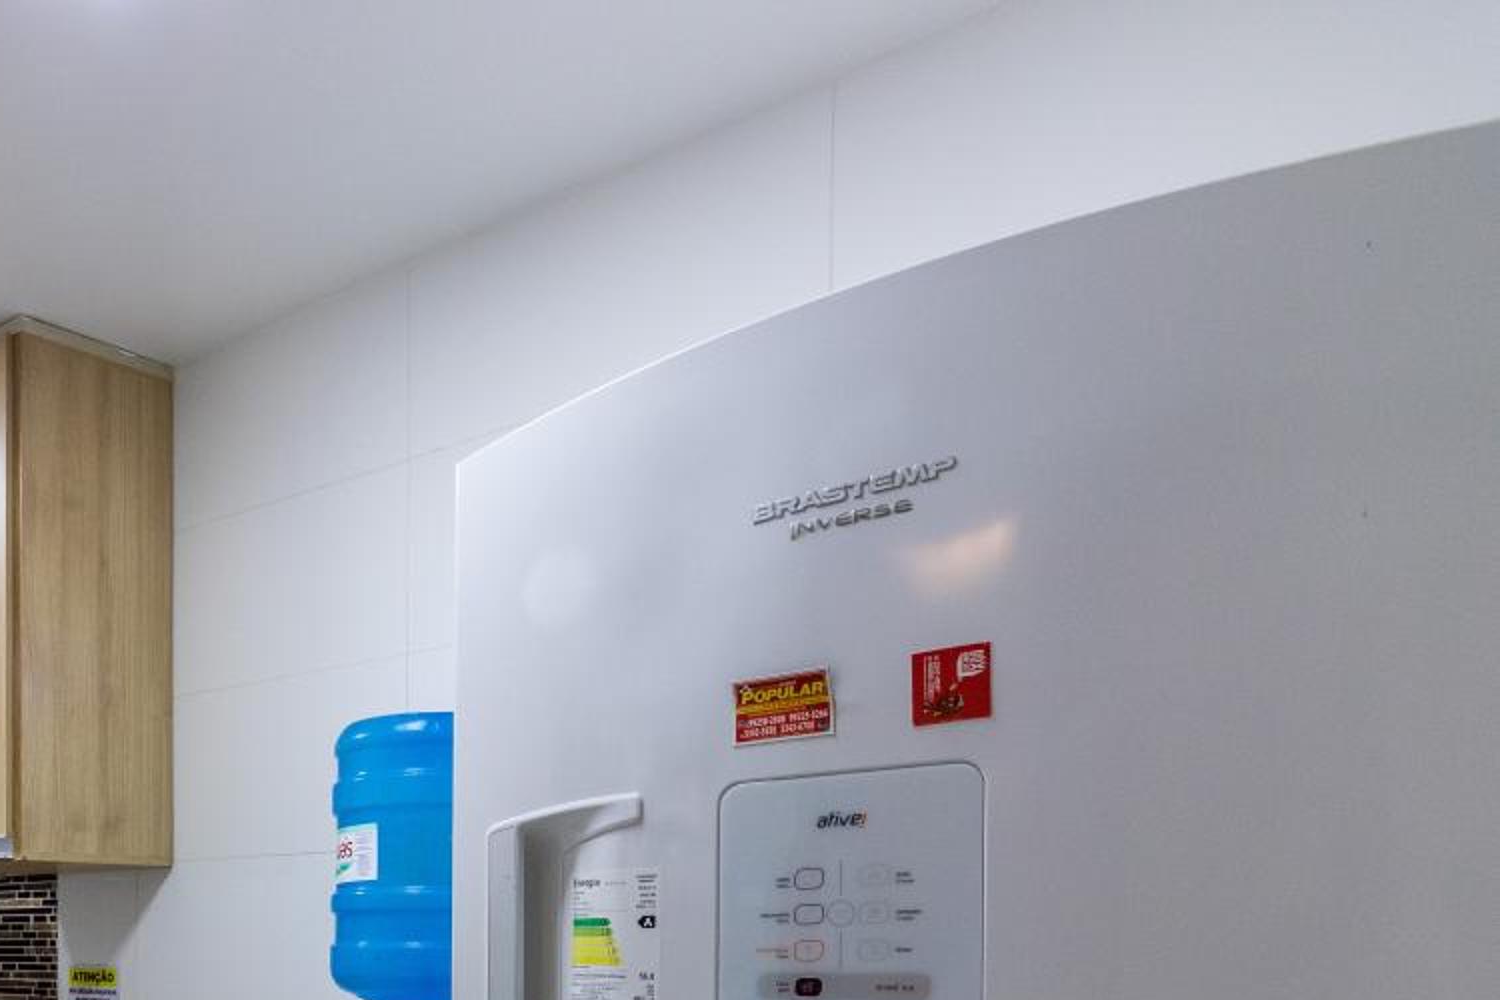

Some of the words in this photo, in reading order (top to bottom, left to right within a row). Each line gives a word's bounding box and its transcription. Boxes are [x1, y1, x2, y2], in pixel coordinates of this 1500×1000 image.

[753, 456, 958, 525] BRASTEMP
[790, 500, 914, 541] INVERSE
[741, 681, 824, 705] POPULAR
